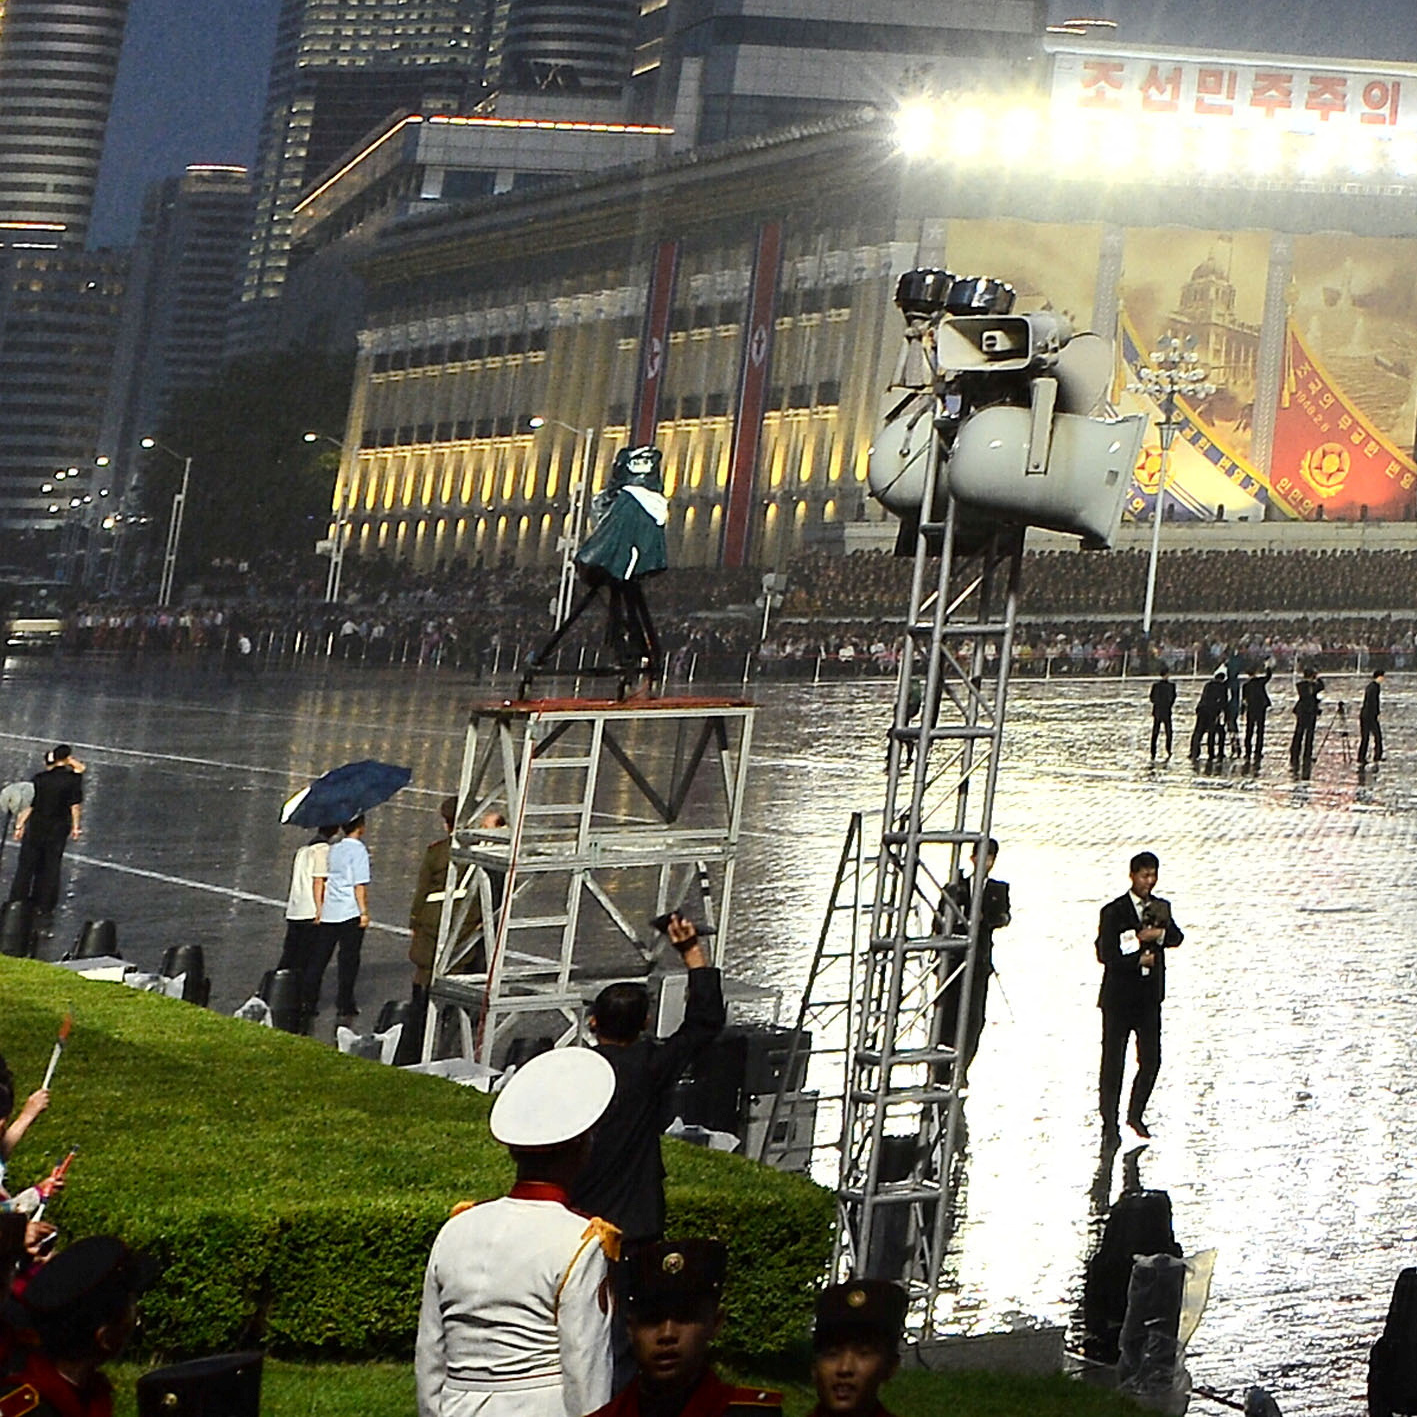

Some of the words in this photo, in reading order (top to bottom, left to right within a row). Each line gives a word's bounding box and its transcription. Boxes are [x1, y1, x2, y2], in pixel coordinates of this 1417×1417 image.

[1081, 60, 1402, 127] 조선민주주의
[1295, 361, 1336, 411] 조국의
[1337, 413, 1381, 459] 무궁한
